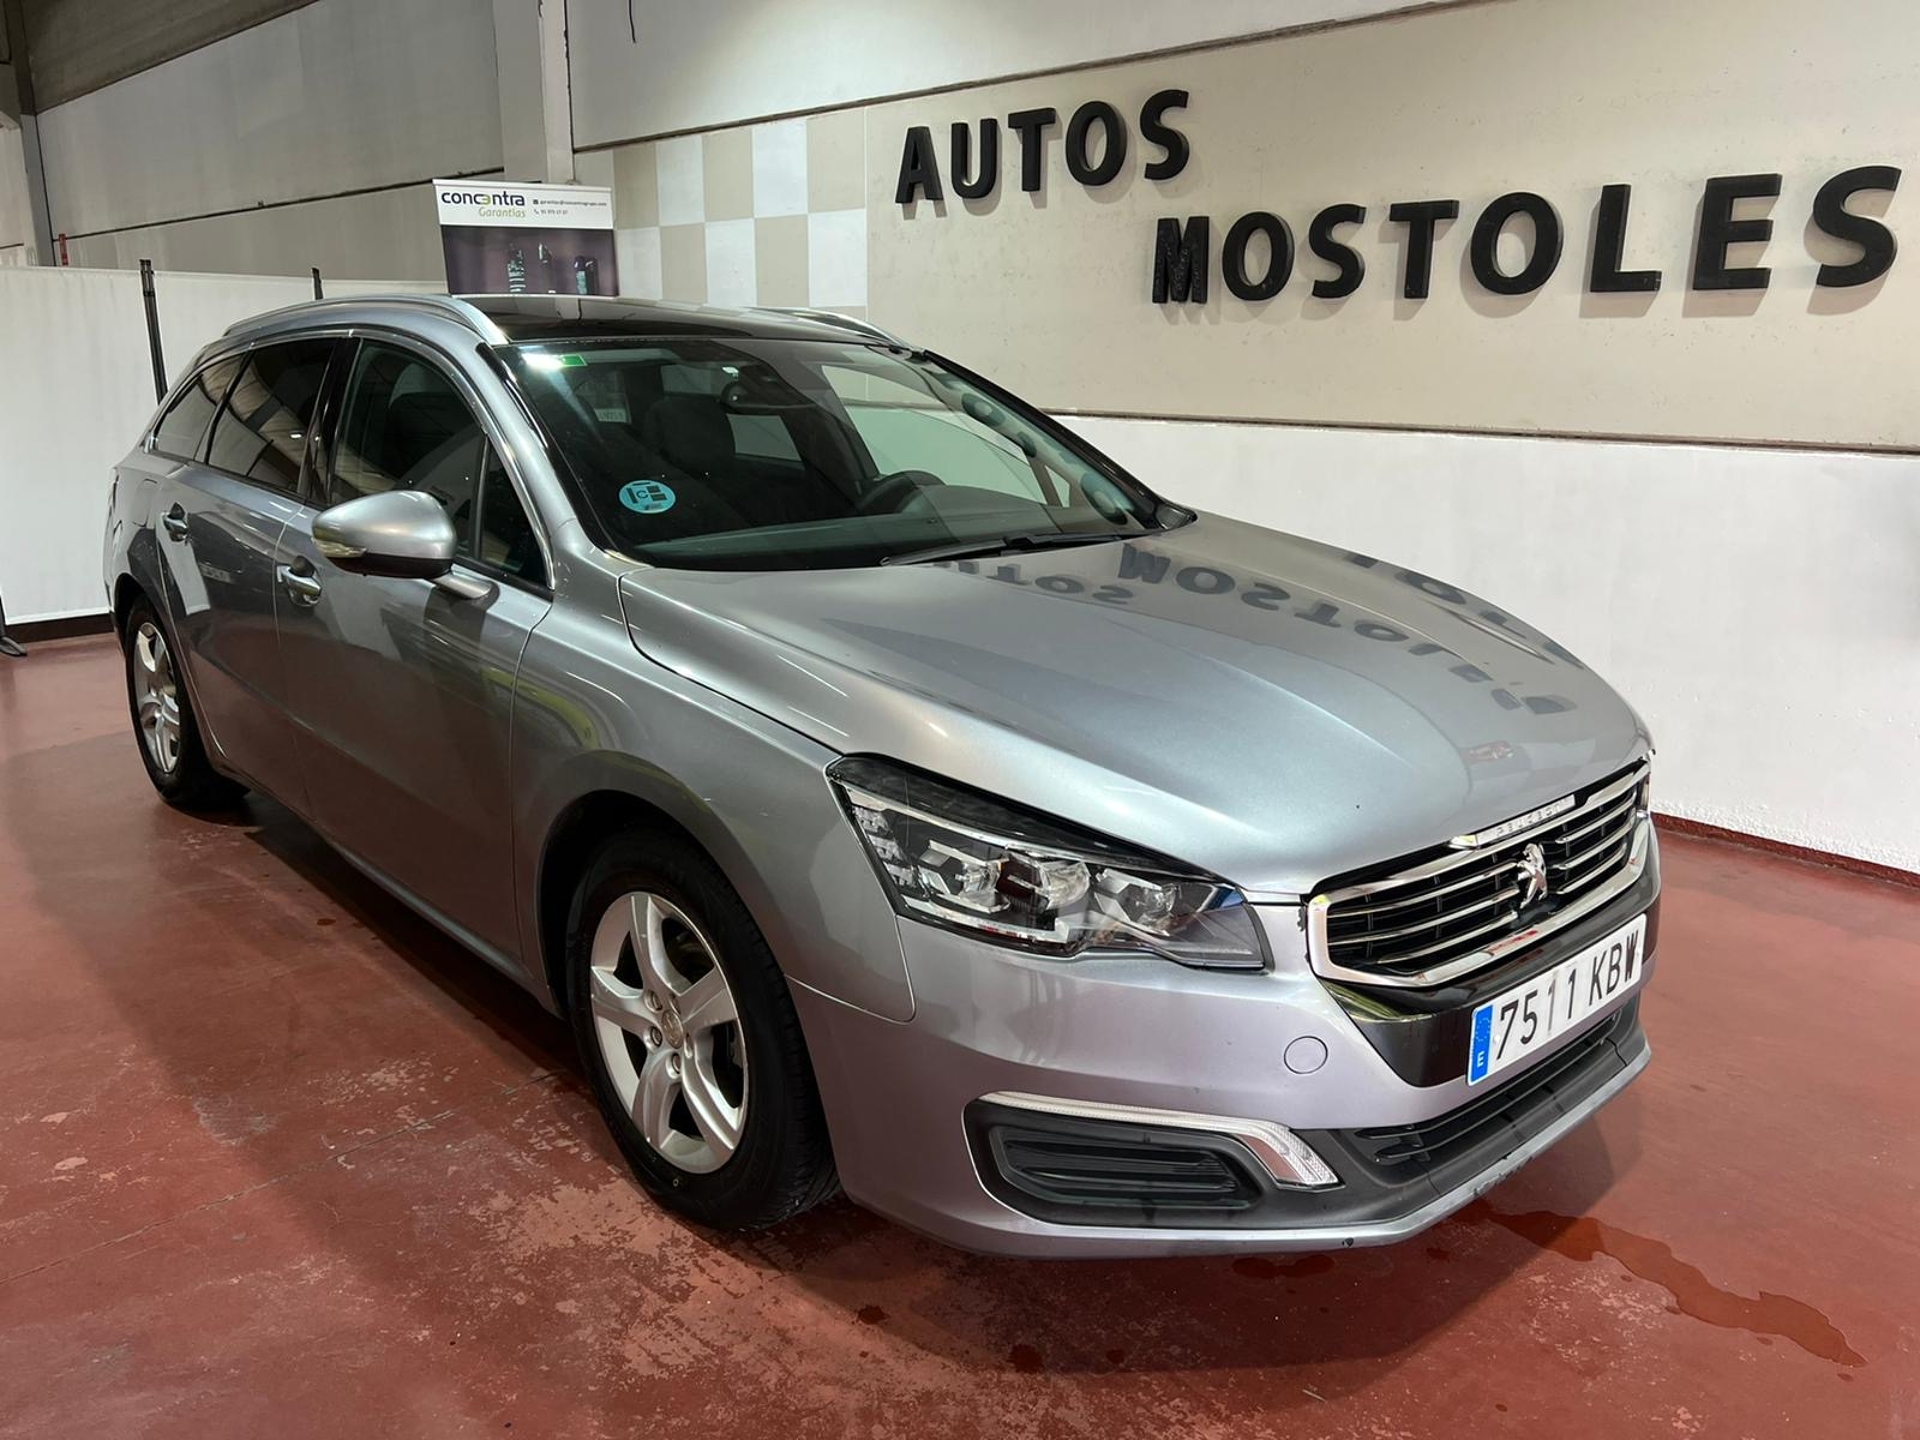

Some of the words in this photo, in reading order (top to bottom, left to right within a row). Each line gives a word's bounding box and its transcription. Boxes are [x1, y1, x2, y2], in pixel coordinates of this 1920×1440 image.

[441, 190, 525, 206] concentra
[896, 89, 1189, 206] AUTOS
[1152, 165, 1901, 304] MOSTOLES
[1496, 968, 1577, 1060] 7511
[1589, 930, 1639, 1006] KBW
[1476, 1050, 1485, 1068] E
